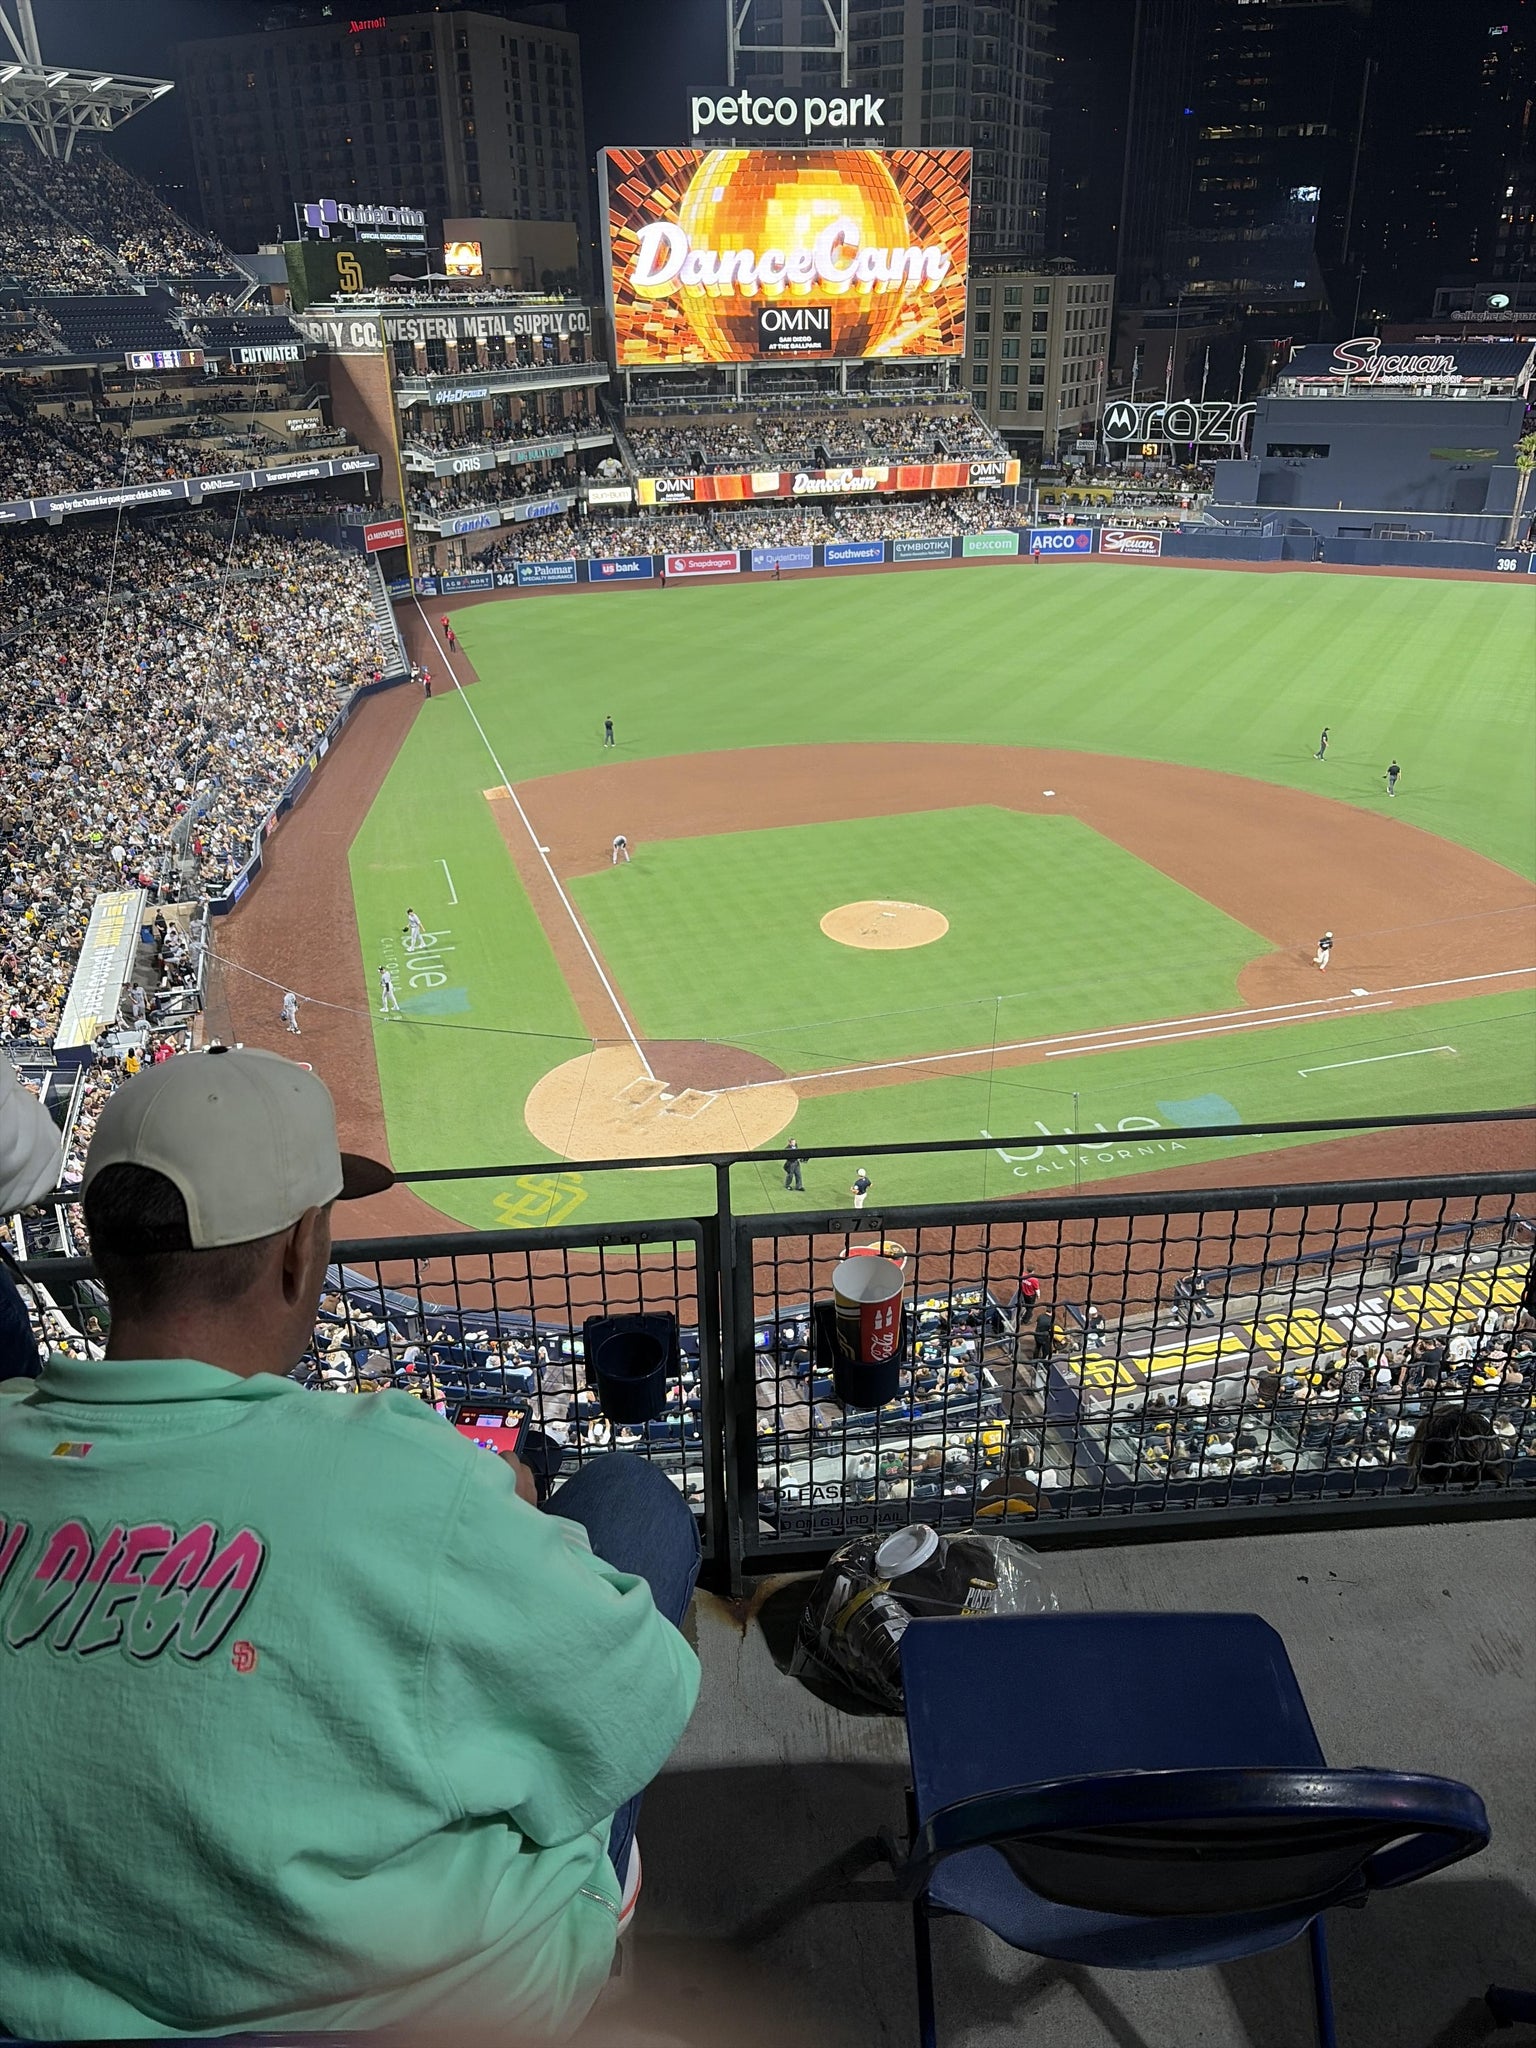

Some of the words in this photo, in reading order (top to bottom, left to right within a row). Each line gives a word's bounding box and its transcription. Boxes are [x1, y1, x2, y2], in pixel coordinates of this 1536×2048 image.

[692, 89, 797, 134] petco
[804, 94, 885, 134] park
[338, 203, 425, 228] QuidelOrtho
[384, 318, 457, 342] WESTERN
[463, 314, 511, 337] METAL
[513, 312, 564, 335] SUPPLY
[568, 311, 590, 332] CO.
[761, 309, 829, 331] OMNI
[350, 323, 383, 347] CO.
[241, 346, 299, 363] CUTWATER
[1329, 337, 1458, 384] Sycuan
[1142, 402, 1257, 442] razr
[342, 461, 360, 470] OMNI
[453, 457, 481, 474] ORIS
[970, 462, 1006, 476] OMNI
[201, 480, 222, 491] OMNI
[656, 479, 695, 492] OMNI
[373, 530, 394, 539] MISSION
[1032, 534, 1075, 549] ARCO
[1104, 532, 1155, 552] Sycuan
[828, 548, 875, 560] Southwest
[896, 541, 950, 552] CYMBIOTIKA
[534, 566, 573, 576] Palomar
[616, 562, 640, 572] bank
[688, 558, 732, 570] Snapdragon
[1497, 558, 1517, 571] 396
[497, 573, 515, 585] 342
[1013, 1141, 1187, 1177] CALIFORNIA
[852, 1218, 862, 1231] 7
[1324, 1297, 1410, 1338] THE
[870, 1332, 894, 1361] Cola
[775, 1485, 851, 1502] PLEASE
[824, 1514, 869, 1526] GUARD
[7, 1521, 266, 1661] DIEGO
